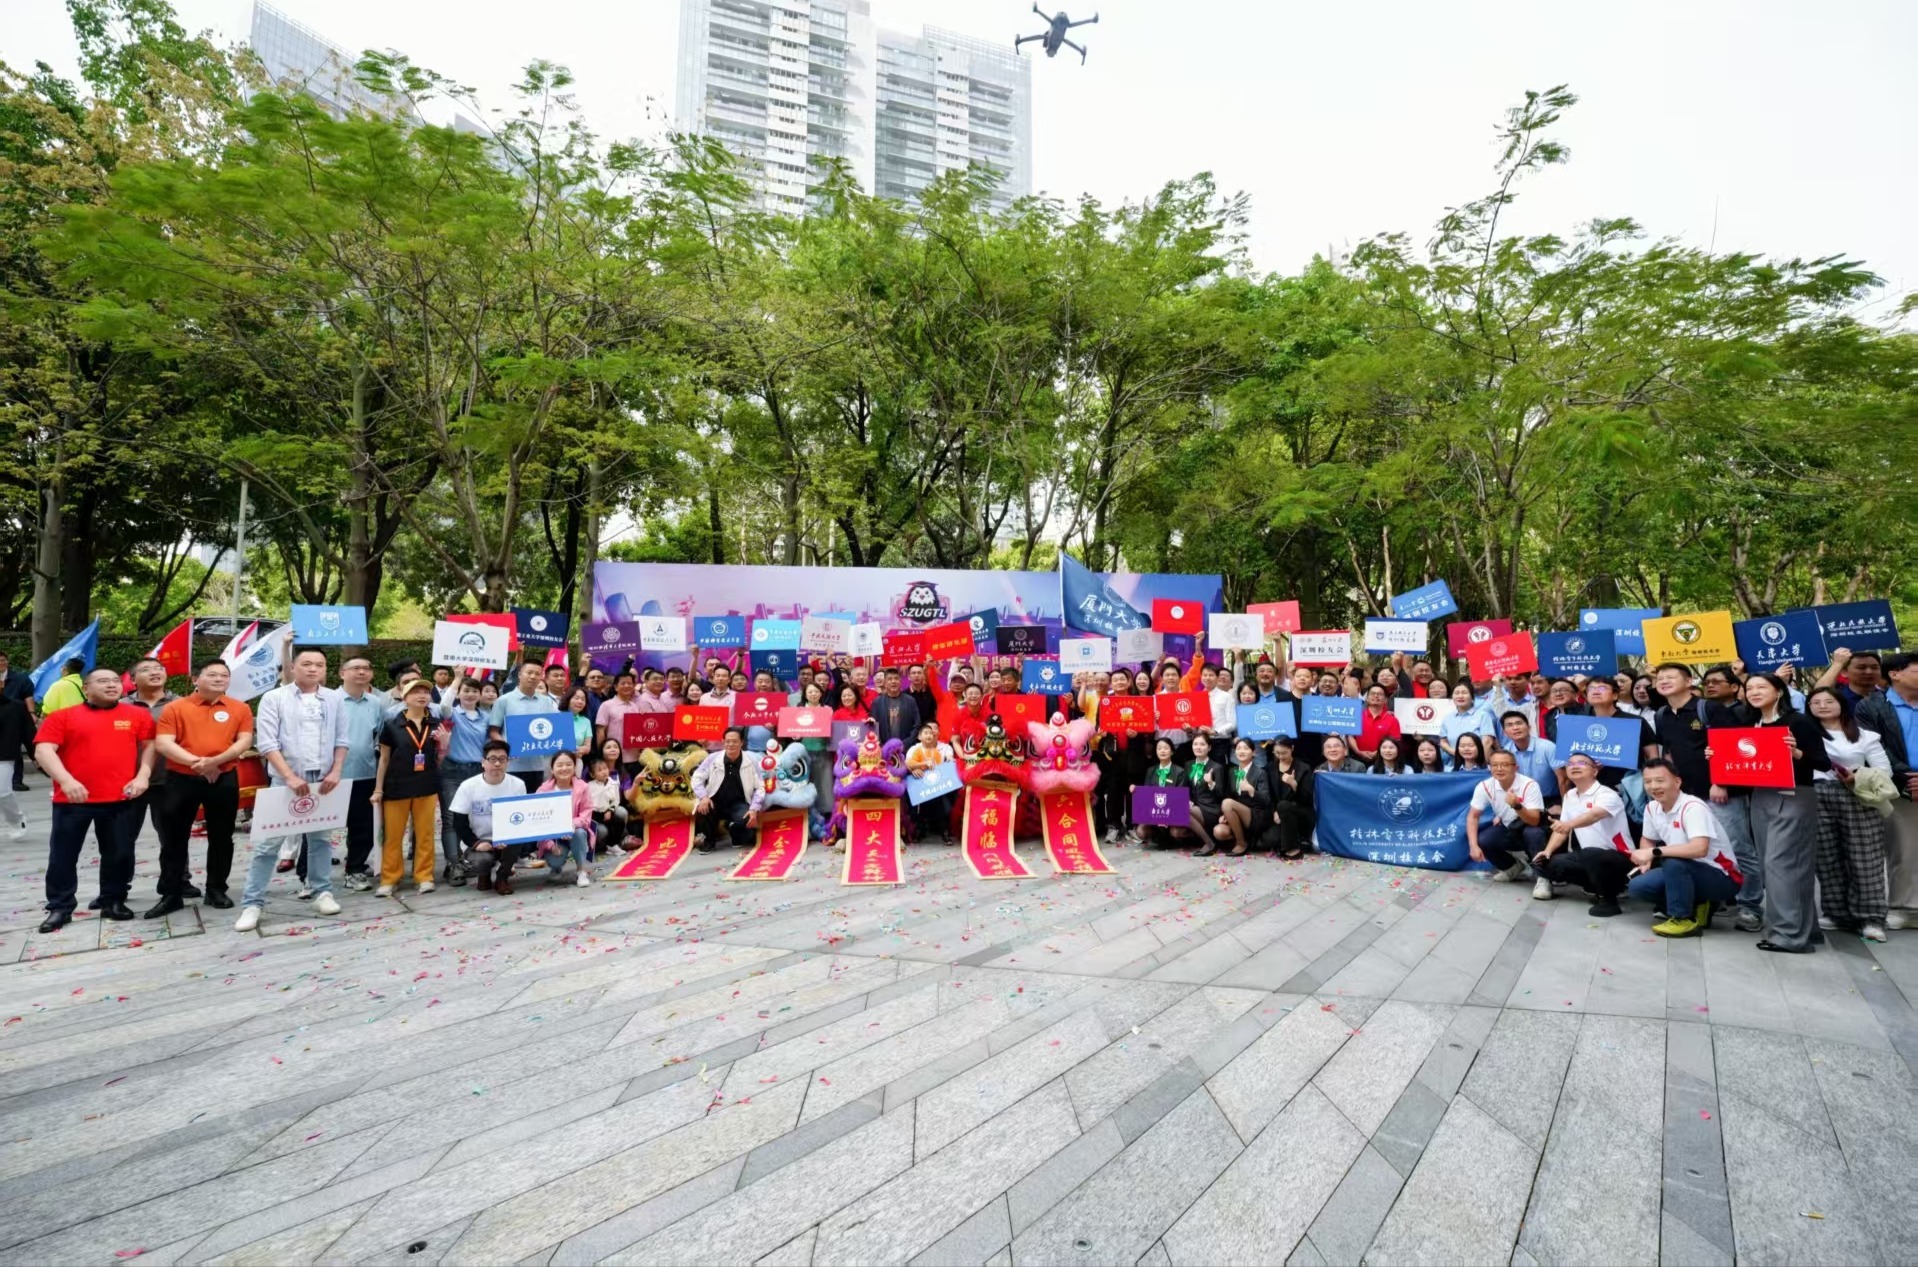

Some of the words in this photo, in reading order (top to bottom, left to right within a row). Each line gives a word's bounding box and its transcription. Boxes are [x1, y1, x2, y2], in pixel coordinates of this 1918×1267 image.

[899, 608, 946, 618] SZUGTL
[1300, 646, 1344, 654] 深圳校友会
[1368, 850, 1446, 864] 深圳校友会
